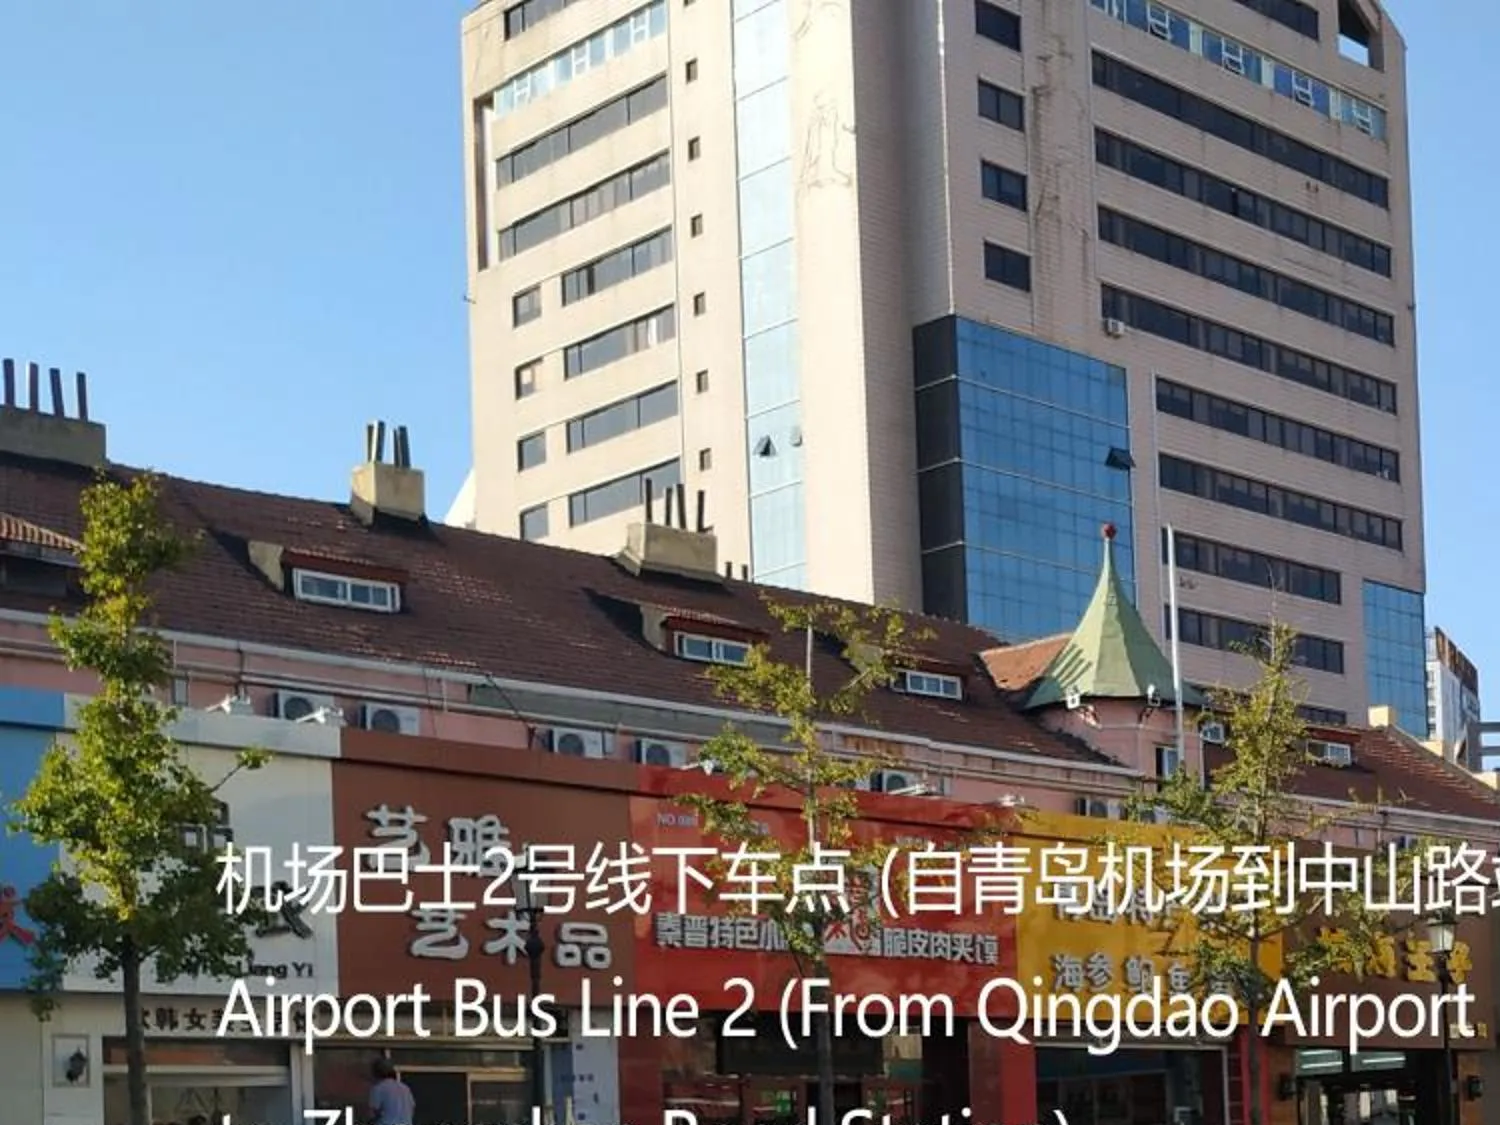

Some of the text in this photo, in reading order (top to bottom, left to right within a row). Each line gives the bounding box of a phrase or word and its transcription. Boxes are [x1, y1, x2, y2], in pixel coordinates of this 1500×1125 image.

[410, 905, 613, 970] 艺术品
[655, 912, 812, 952] 秦晋特色小
